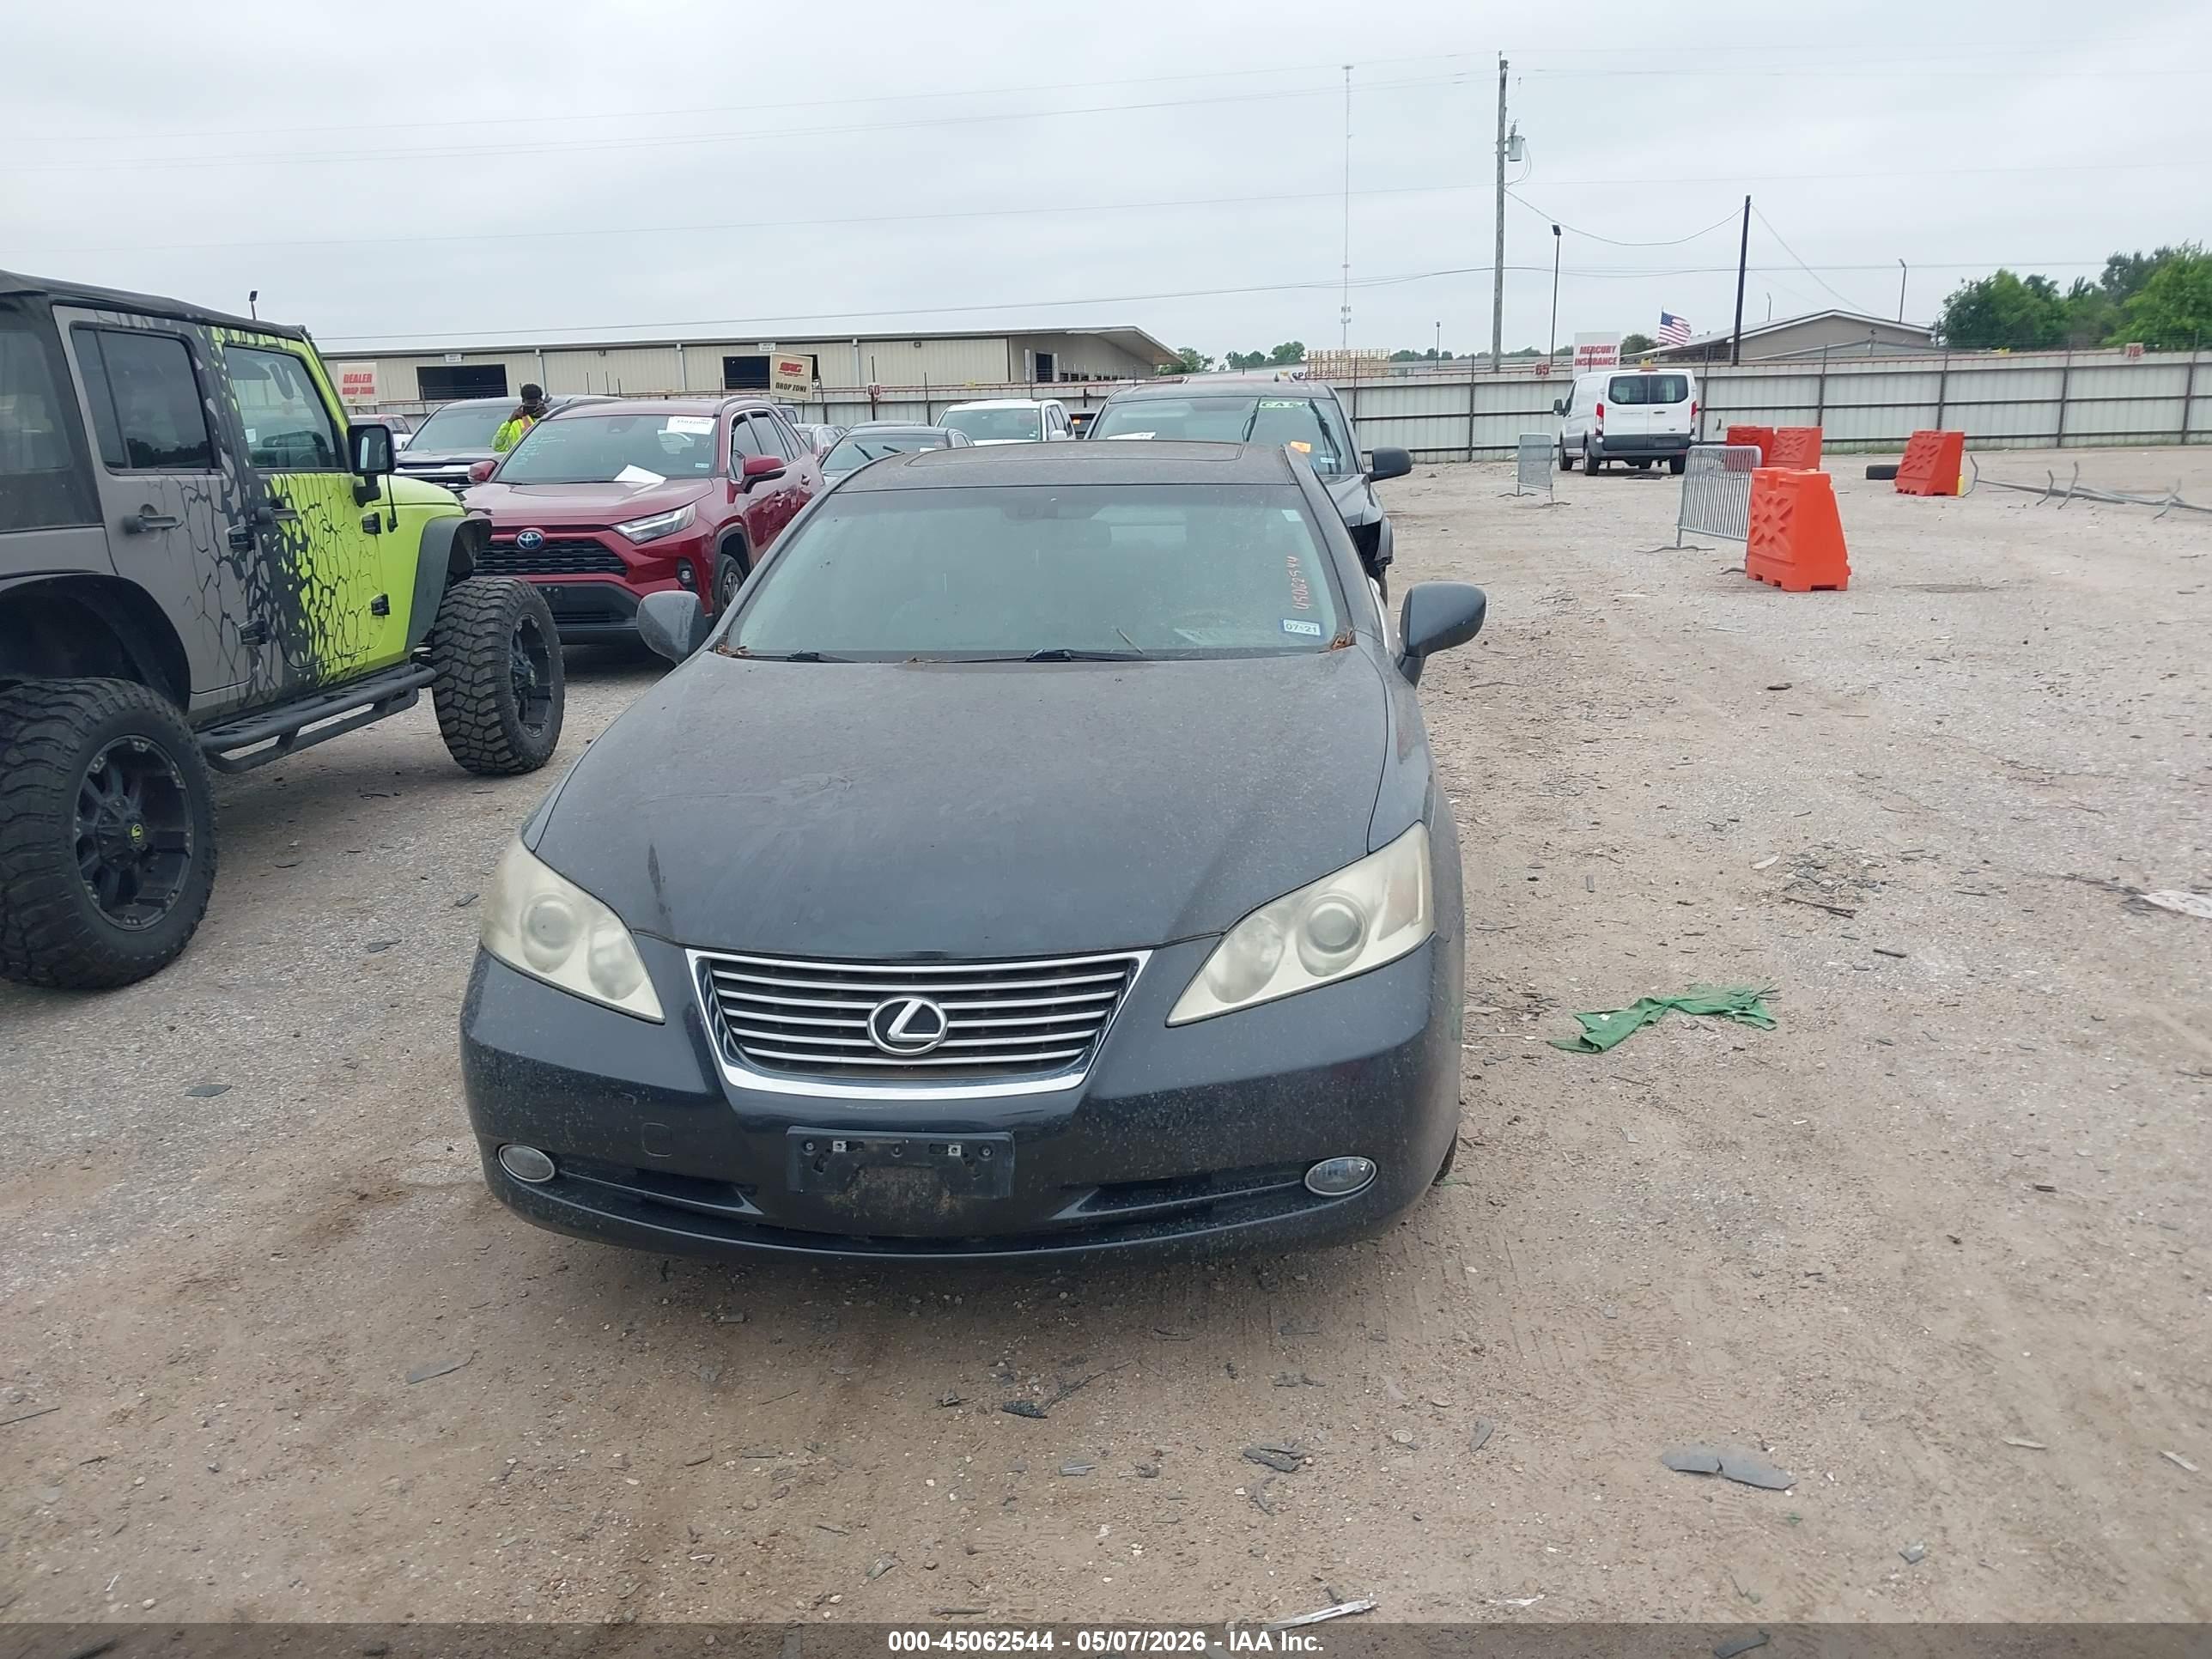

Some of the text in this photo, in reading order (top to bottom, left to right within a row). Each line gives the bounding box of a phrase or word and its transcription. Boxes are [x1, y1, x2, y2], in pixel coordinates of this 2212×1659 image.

[1580, 345, 1616, 354] MERCURY
[343, 374, 372, 383] DEALER
[775, 382, 807, 392] DROP ZONE
